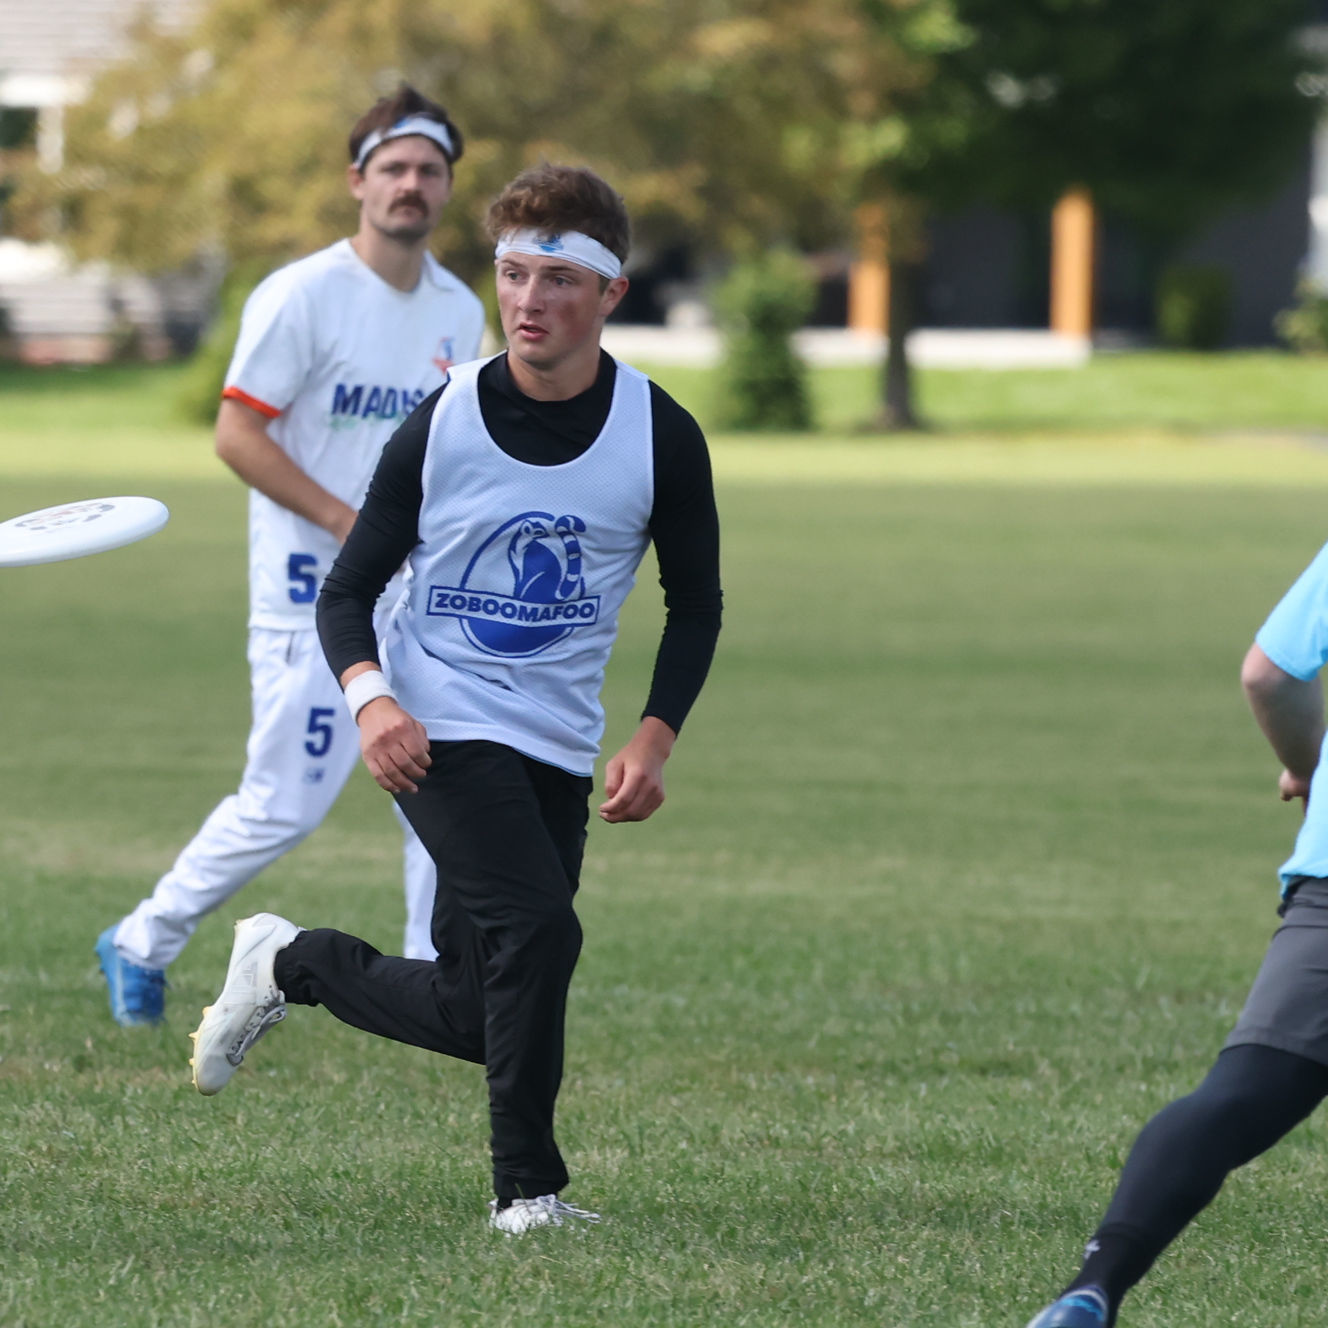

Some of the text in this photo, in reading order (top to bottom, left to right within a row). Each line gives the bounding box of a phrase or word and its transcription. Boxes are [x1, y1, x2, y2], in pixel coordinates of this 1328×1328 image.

[288, 554, 317, 603] 5
[435, 592, 595, 622] ZOBOOMAFOO
[305, 707, 336, 757] 5
